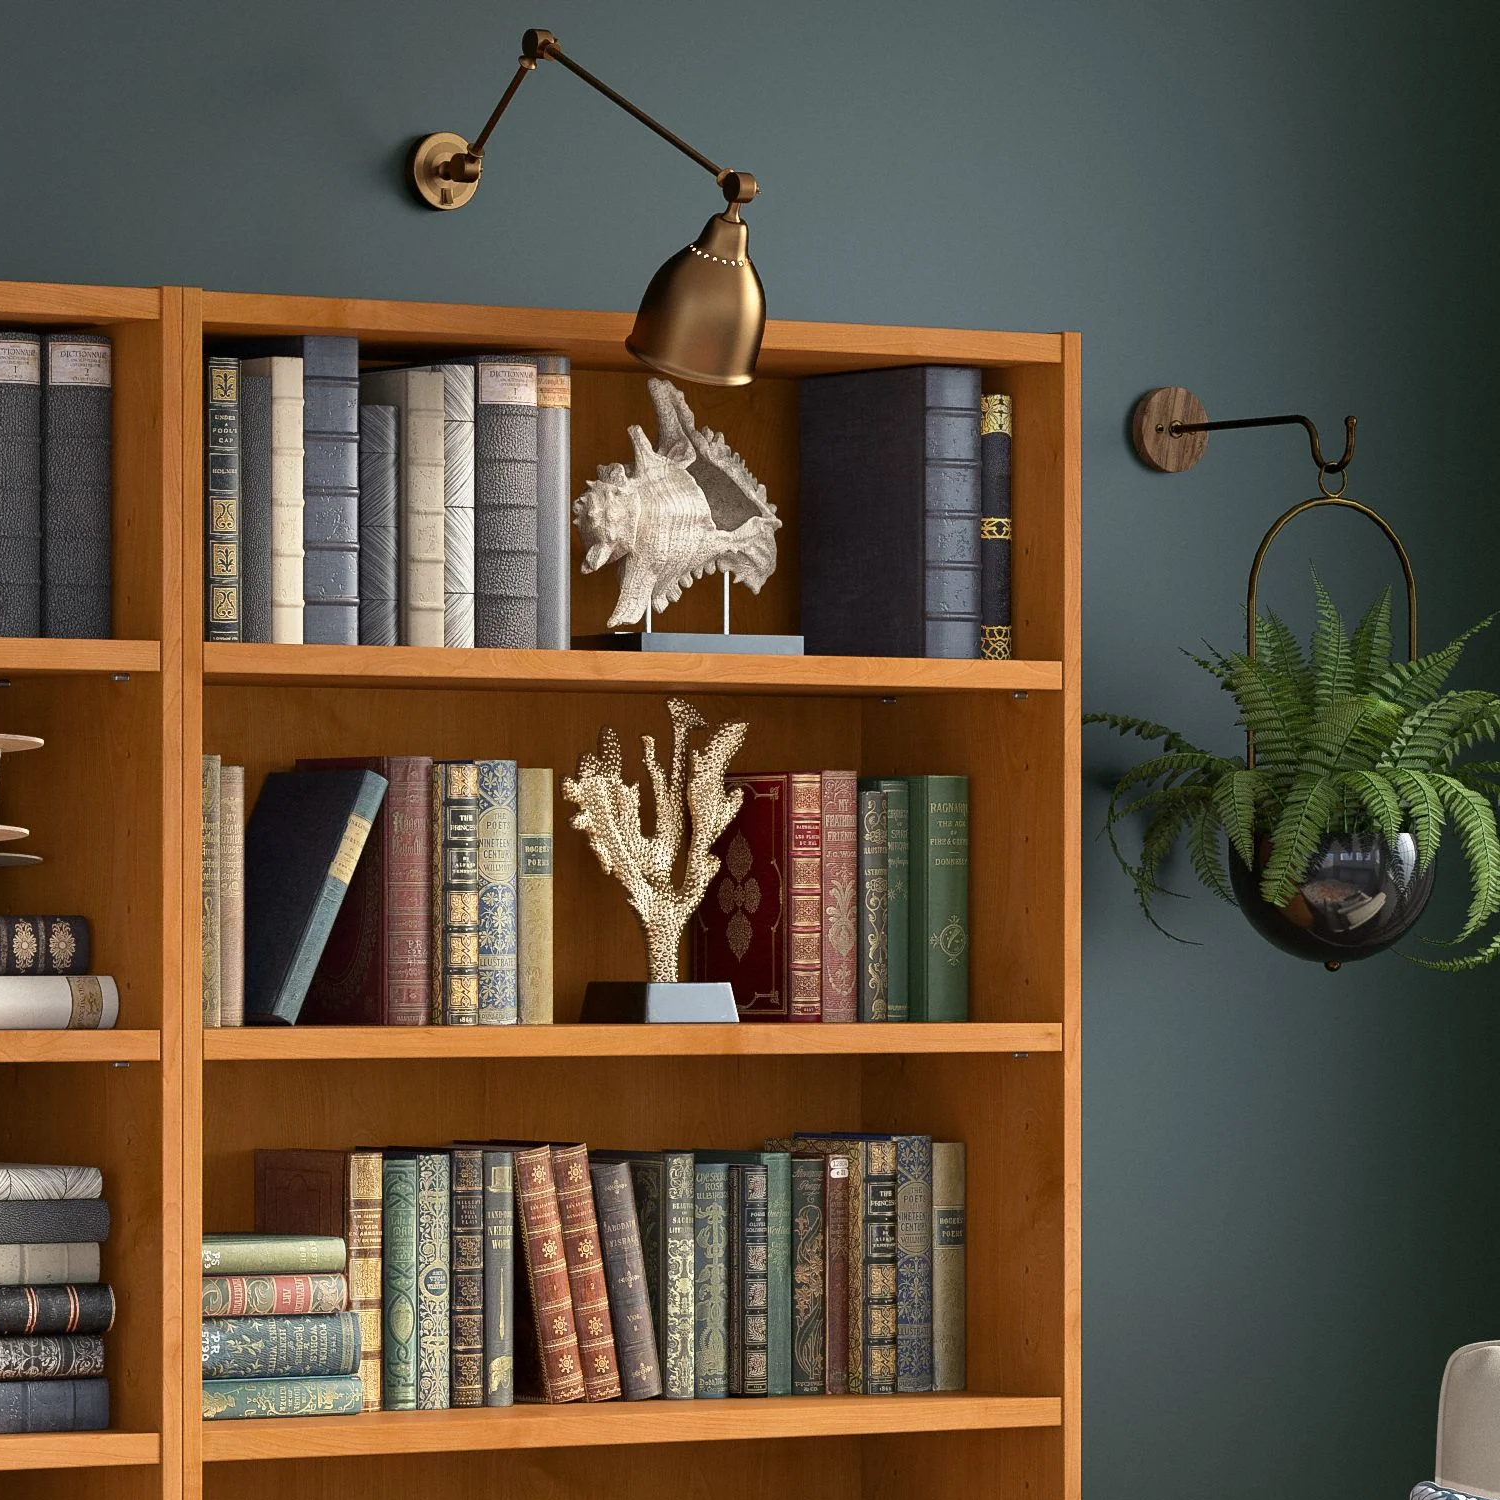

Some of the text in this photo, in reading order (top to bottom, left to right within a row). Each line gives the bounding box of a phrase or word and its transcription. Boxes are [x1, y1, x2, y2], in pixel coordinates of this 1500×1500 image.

[459, 814, 473, 822] THE
[486, 821, 511, 830] POETS
[491, 1240, 511, 1250] WORK
[211, 1251, 221, 1267] PS
[282, 1287, 292, 1305] ART
[626, 1313, 642, 1322] VOL.
[211, 1331, 221, 1355] PR
[278, 1328, 287, 1362] HENRY
[309, 1324, 319, 1362] WORKS
[318, 1323, 328, 1367] POETICAL
[330, 1333, 338, 1353] THE
